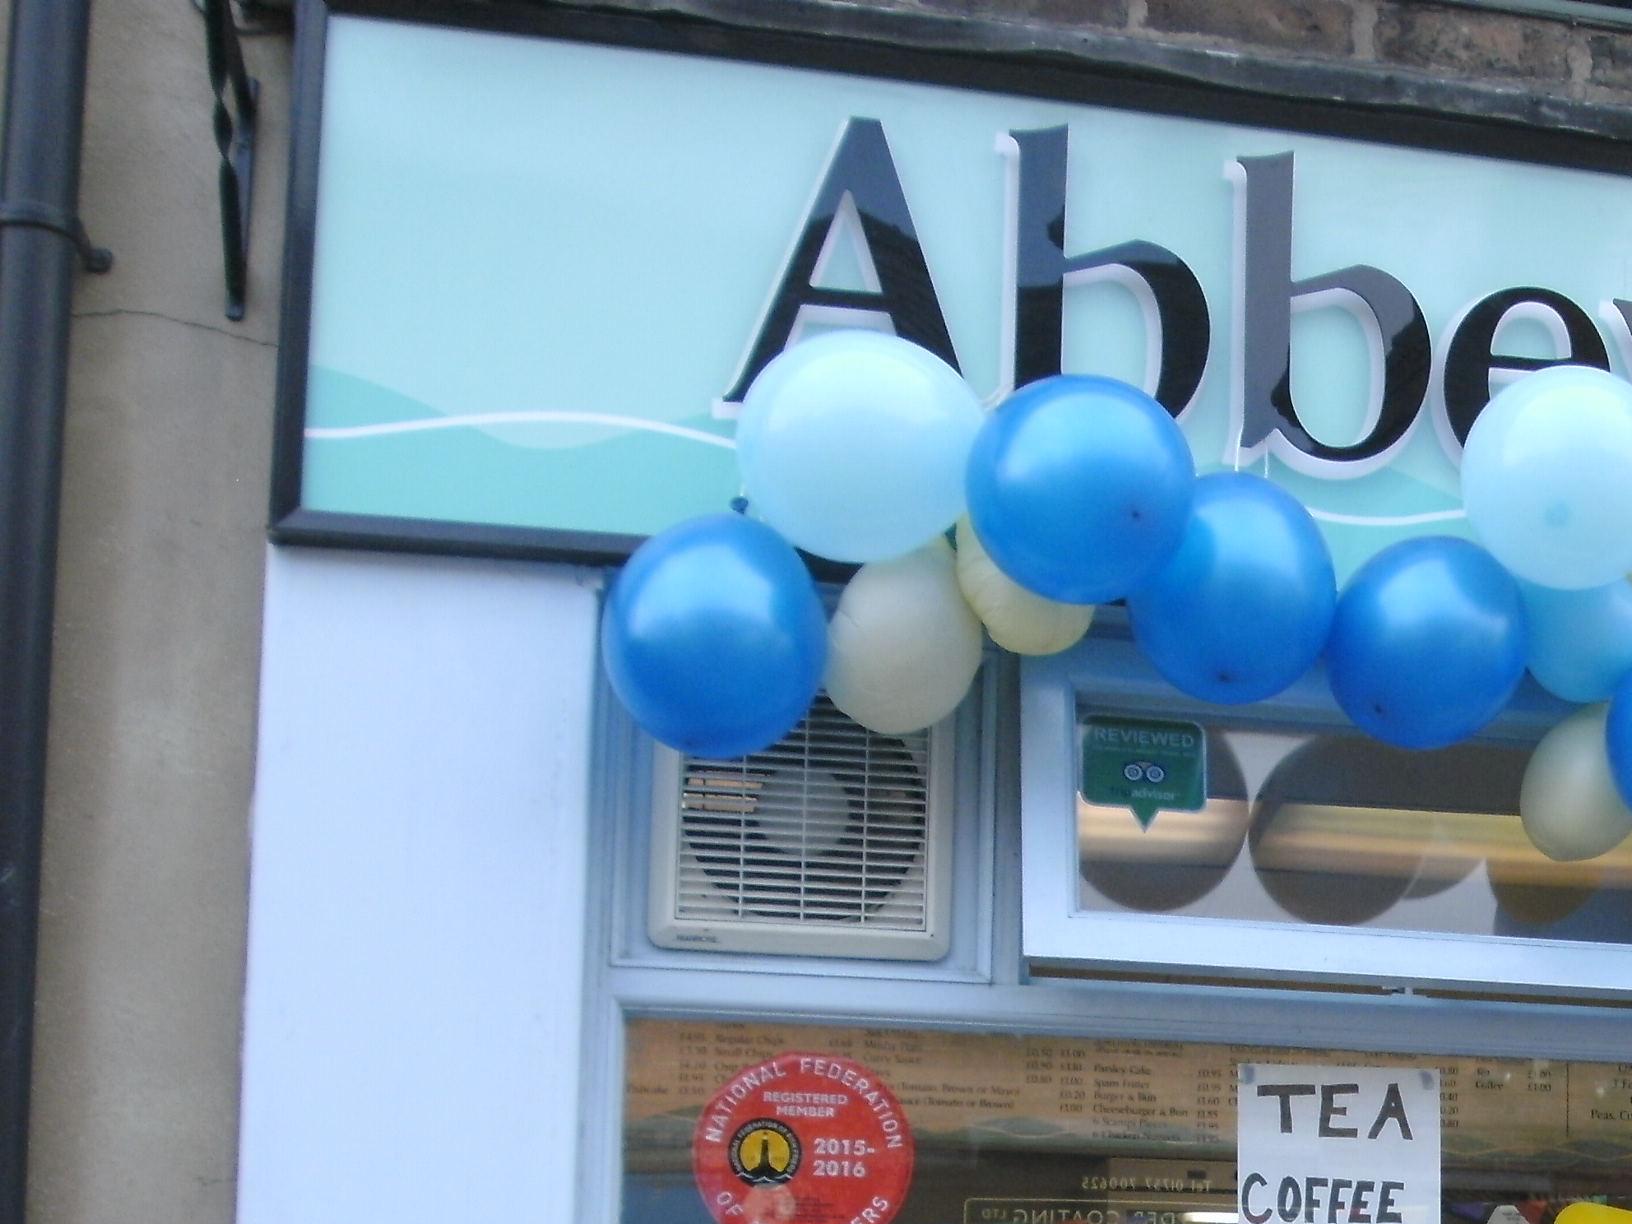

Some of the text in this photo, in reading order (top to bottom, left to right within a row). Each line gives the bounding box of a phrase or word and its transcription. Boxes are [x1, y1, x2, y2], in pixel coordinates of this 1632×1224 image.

[1094, 727, 1194, 748] REVIEWED
[704, 1056, 904, 1150] NATIONAL FEDERATION
[762, 1090, 849, 1105] REGISTERED
[776, 1105, 836, 1118] MEMBER
[1256, 1082, 1414, 1141] TEA
[812, 1137, 876, 1156] 2015-
[812, 1160, 867, 1178] 2016
[715, 1190, 745, 1218] OF
[1241, 1172, 1405, 1224] COFFEE
